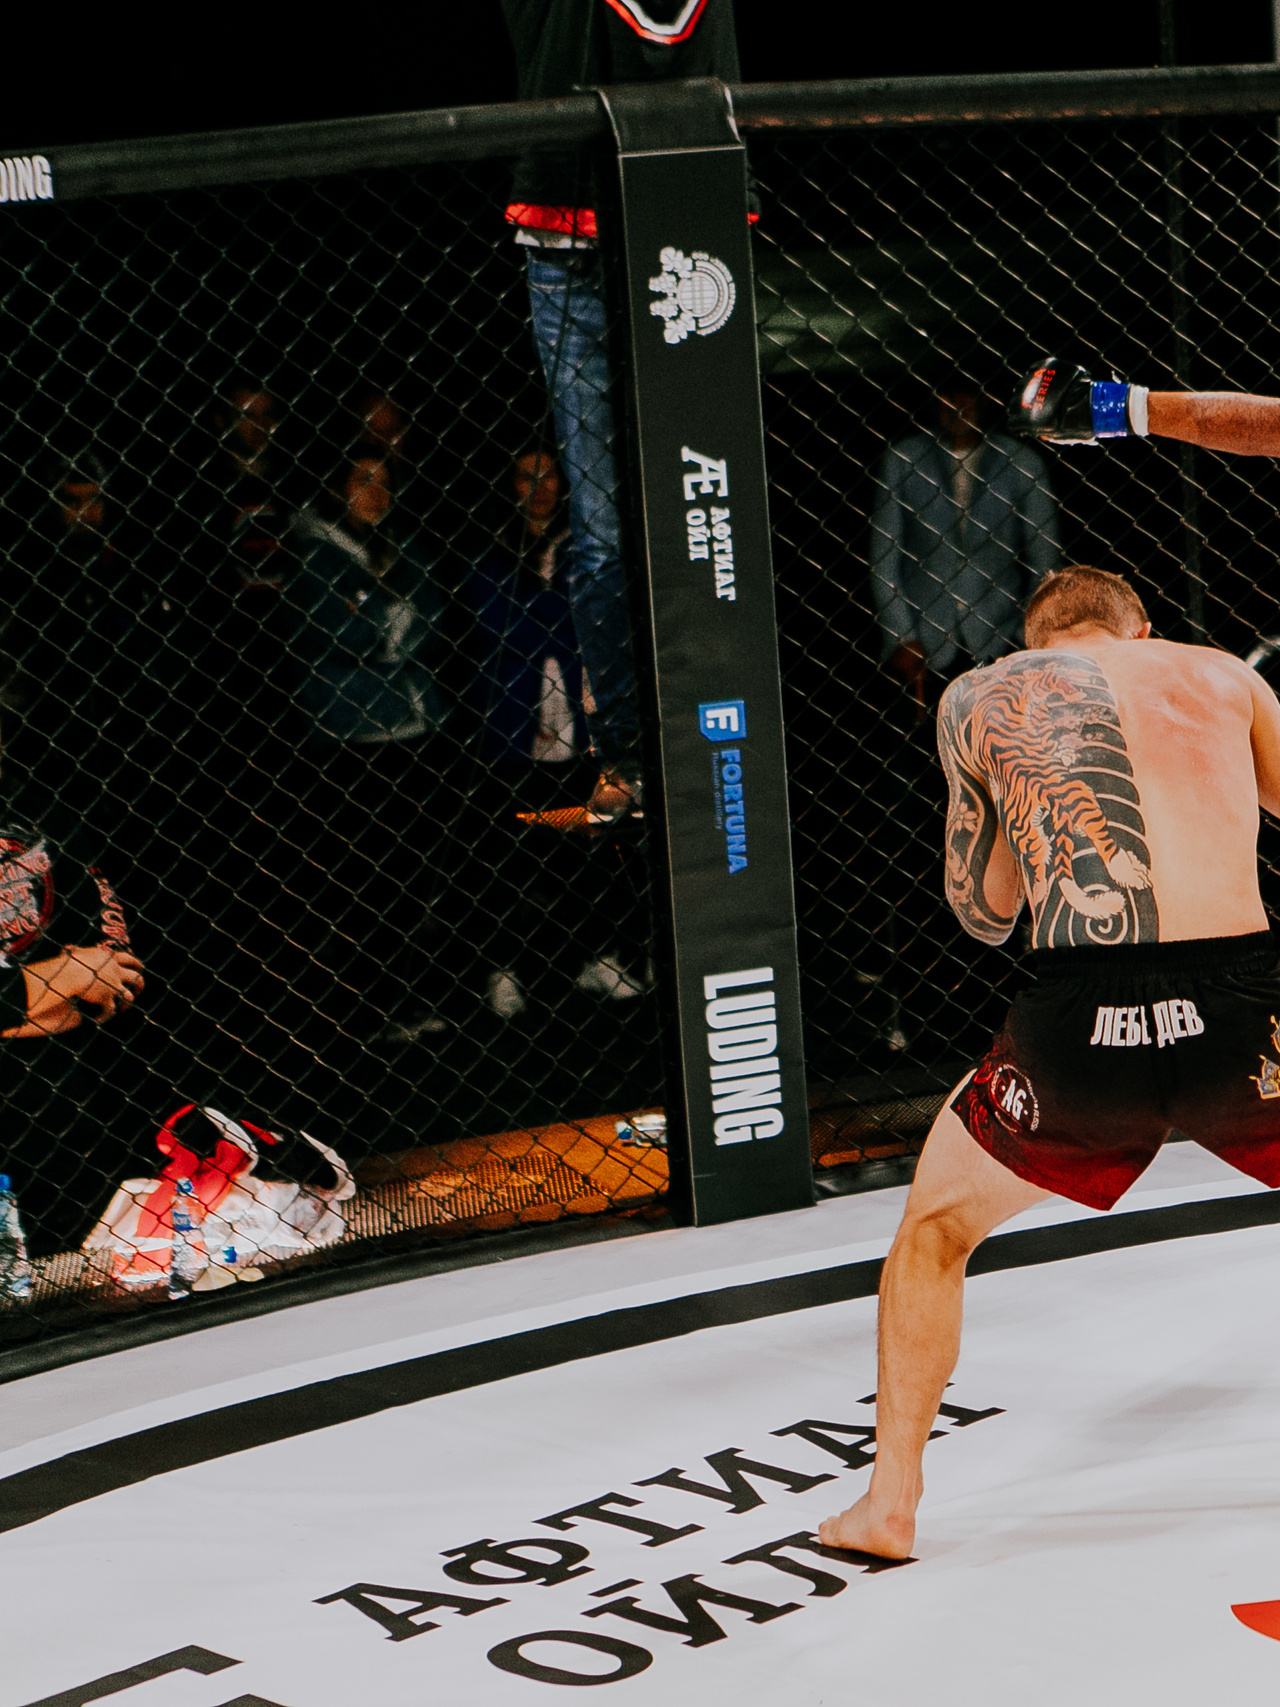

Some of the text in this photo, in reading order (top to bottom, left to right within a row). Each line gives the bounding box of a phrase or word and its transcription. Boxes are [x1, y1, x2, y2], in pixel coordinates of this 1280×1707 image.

[686, 508, 711, 562] ОЙЛ
[720, 749, 748, 875] FORTUNA
[703, 966, 785, 1147] LUDING
